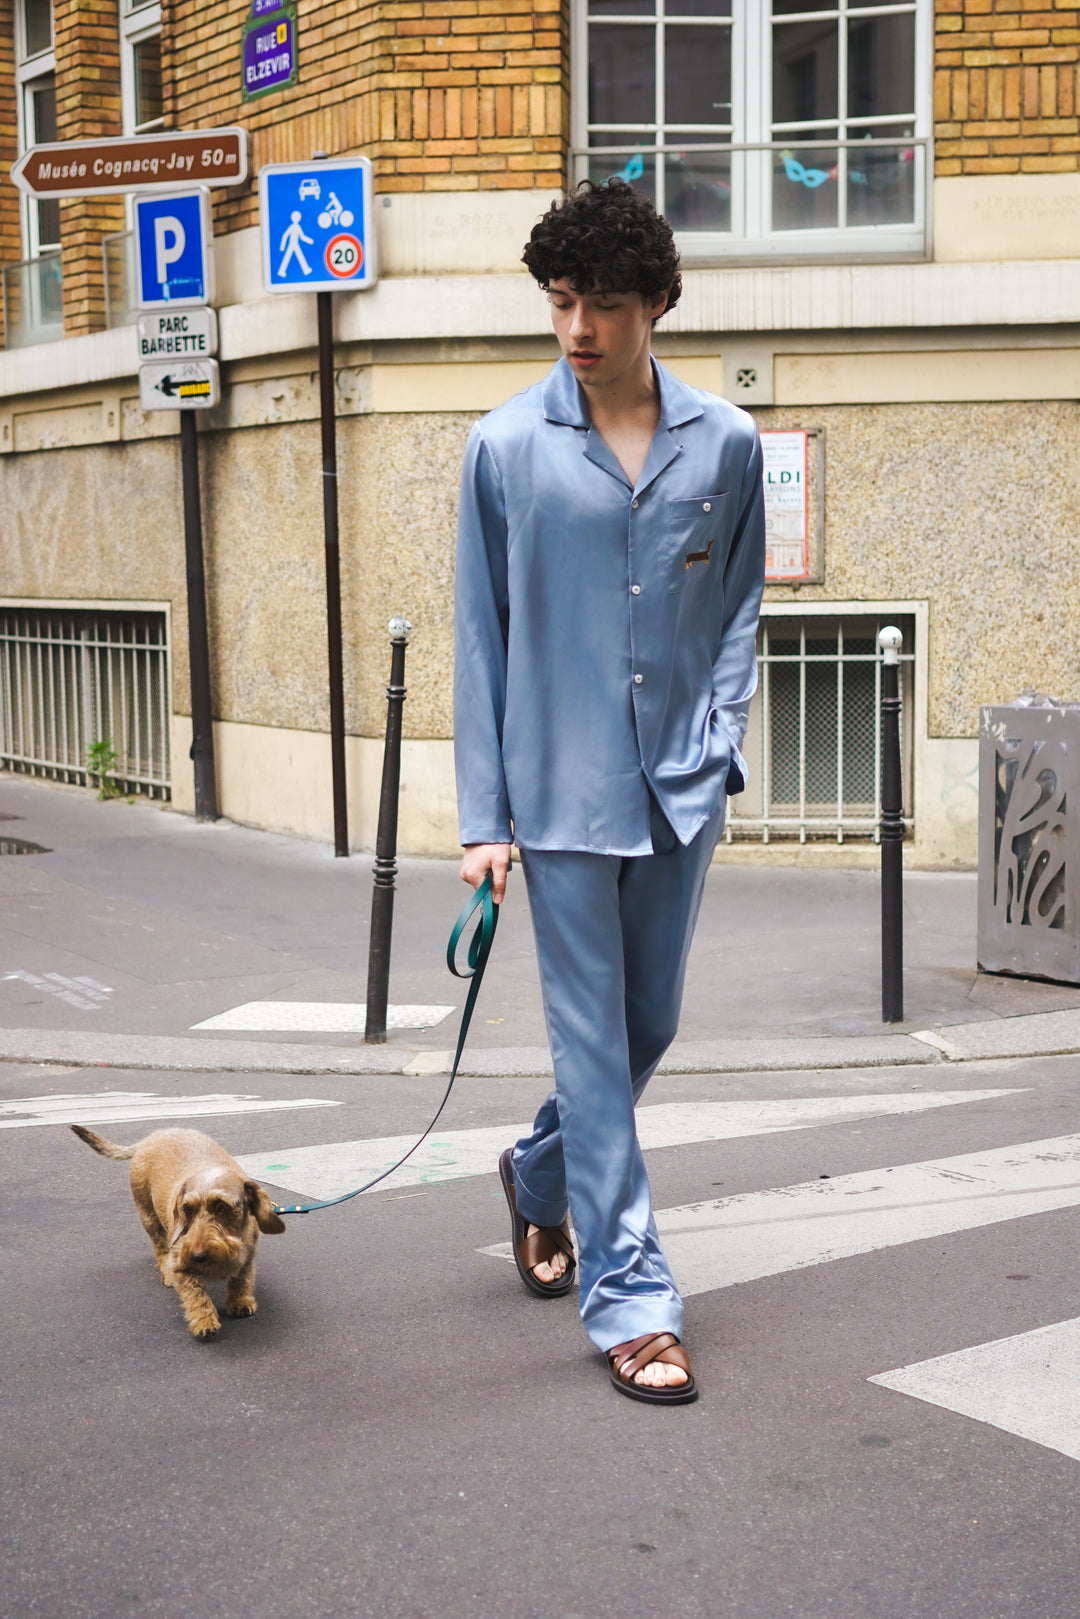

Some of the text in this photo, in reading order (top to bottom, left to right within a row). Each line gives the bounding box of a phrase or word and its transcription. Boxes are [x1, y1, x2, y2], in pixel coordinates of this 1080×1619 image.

[256, 31, 277, 54] RUE
[246, 52, 290, 83] ELZEVIR
[38, 161, 87, 180] Musée
[93, 152, 194, 178] Cognacq-Jay
[154, 215, 186, 284] P
[334, 248, 354, 264] 20
[159, 316, 188, 333] PARC
[141, 334, 206, 355] BARBETTE
[768, 471, 800, 484] LDI
